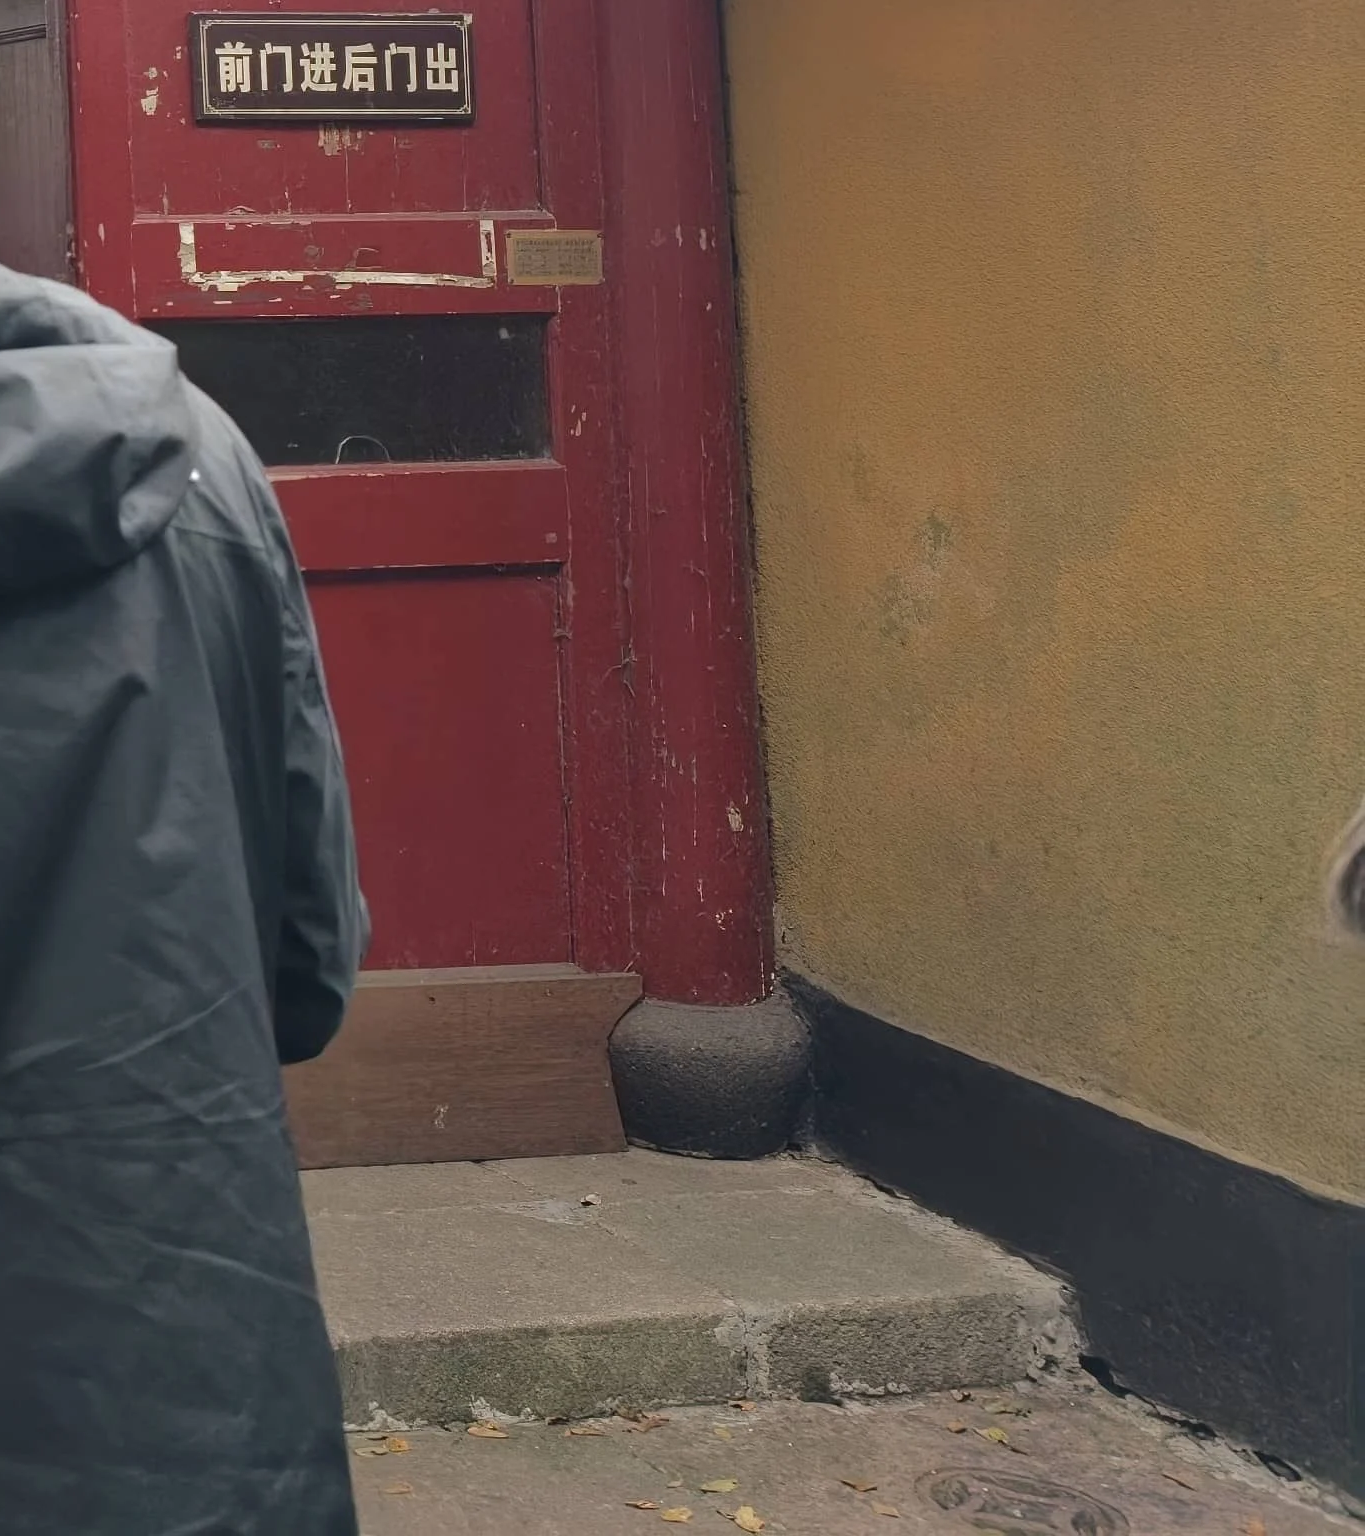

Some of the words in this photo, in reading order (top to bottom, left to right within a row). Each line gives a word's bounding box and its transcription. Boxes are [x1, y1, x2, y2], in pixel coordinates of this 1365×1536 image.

[215, 41, 459, 93] 前门进后门出
